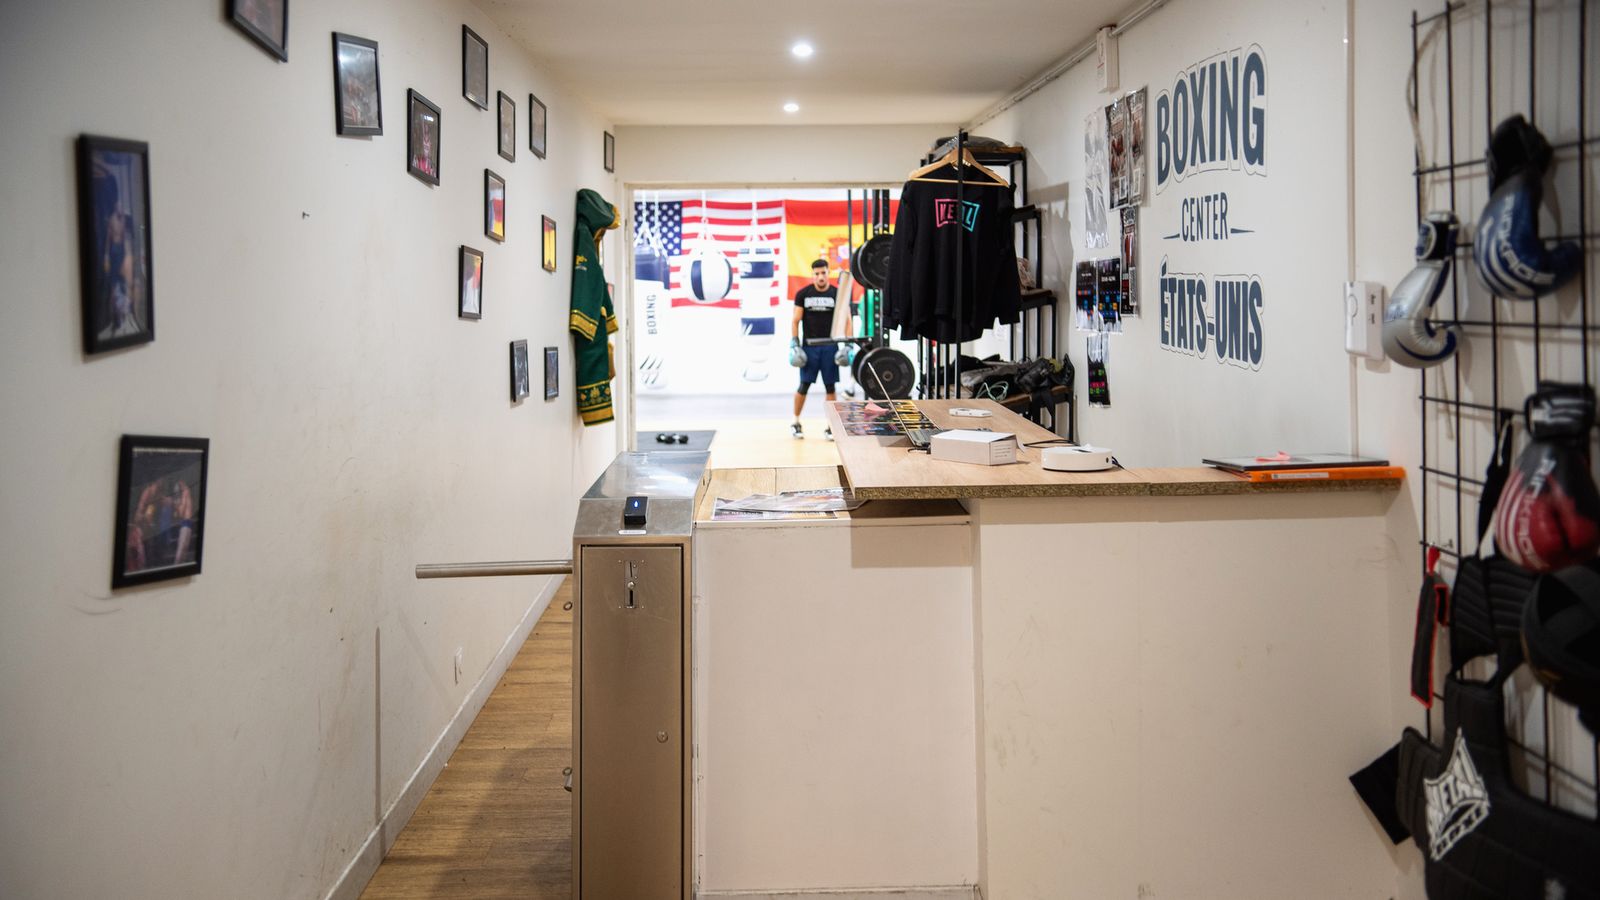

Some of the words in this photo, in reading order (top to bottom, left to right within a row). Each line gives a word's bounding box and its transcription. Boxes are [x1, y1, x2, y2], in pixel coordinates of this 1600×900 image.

[1157, 52, 1265, 186] BOXING
[1182, 192, 1228, 242] CENTER
[646, 294, 657, 335] BOXING
[1160, 261, 1263, 365] ÉTATS-UNIS
